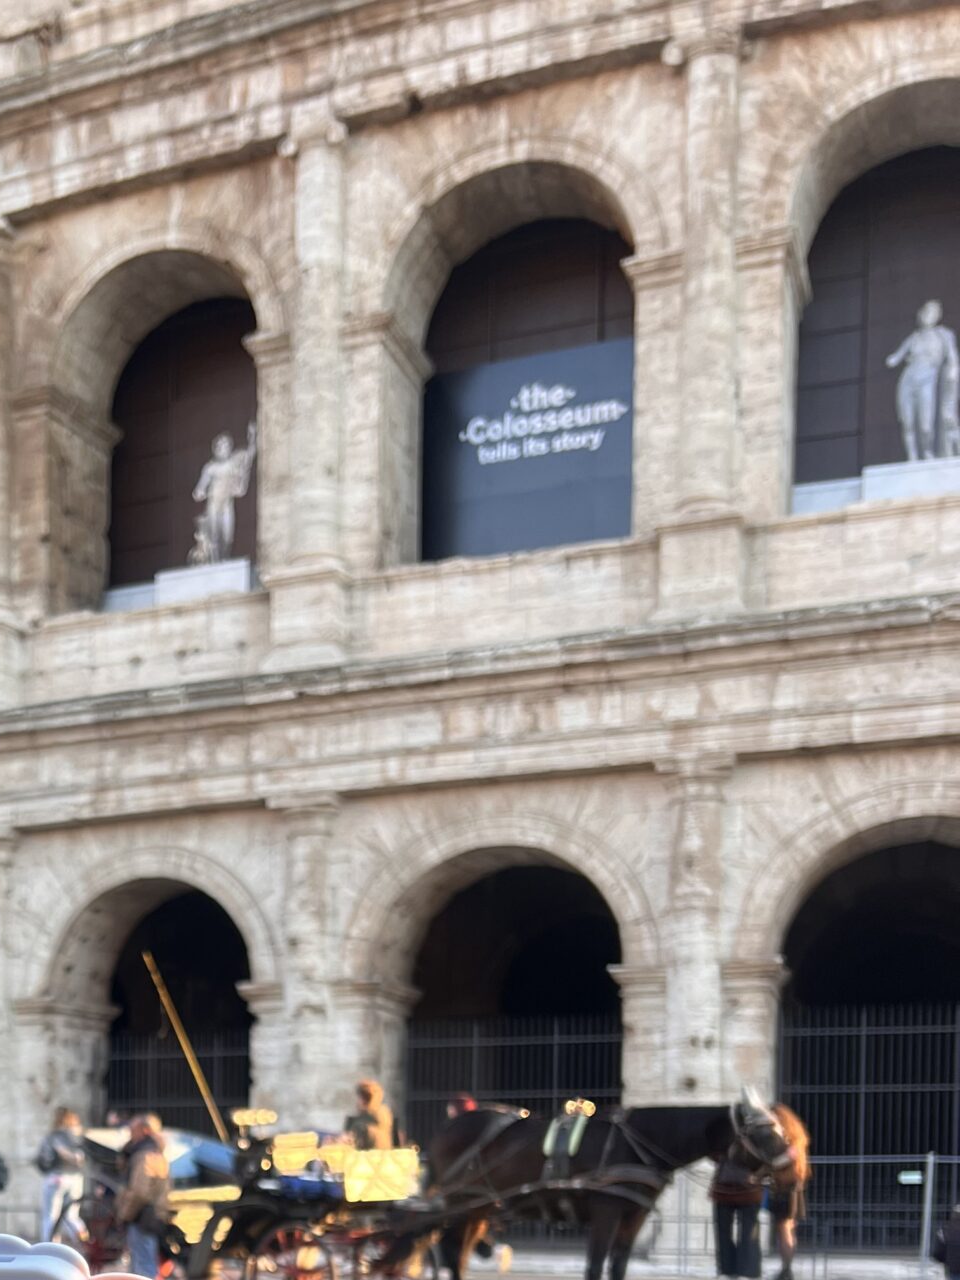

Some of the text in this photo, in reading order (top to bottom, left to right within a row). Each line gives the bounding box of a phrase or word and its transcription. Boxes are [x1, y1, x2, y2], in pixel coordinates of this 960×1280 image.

[518, 382, 566, 412] the
[466, 400, 620, 445] Colosseum
[522, 437, 550, 458] its
[551, 429, 606, 453] story
